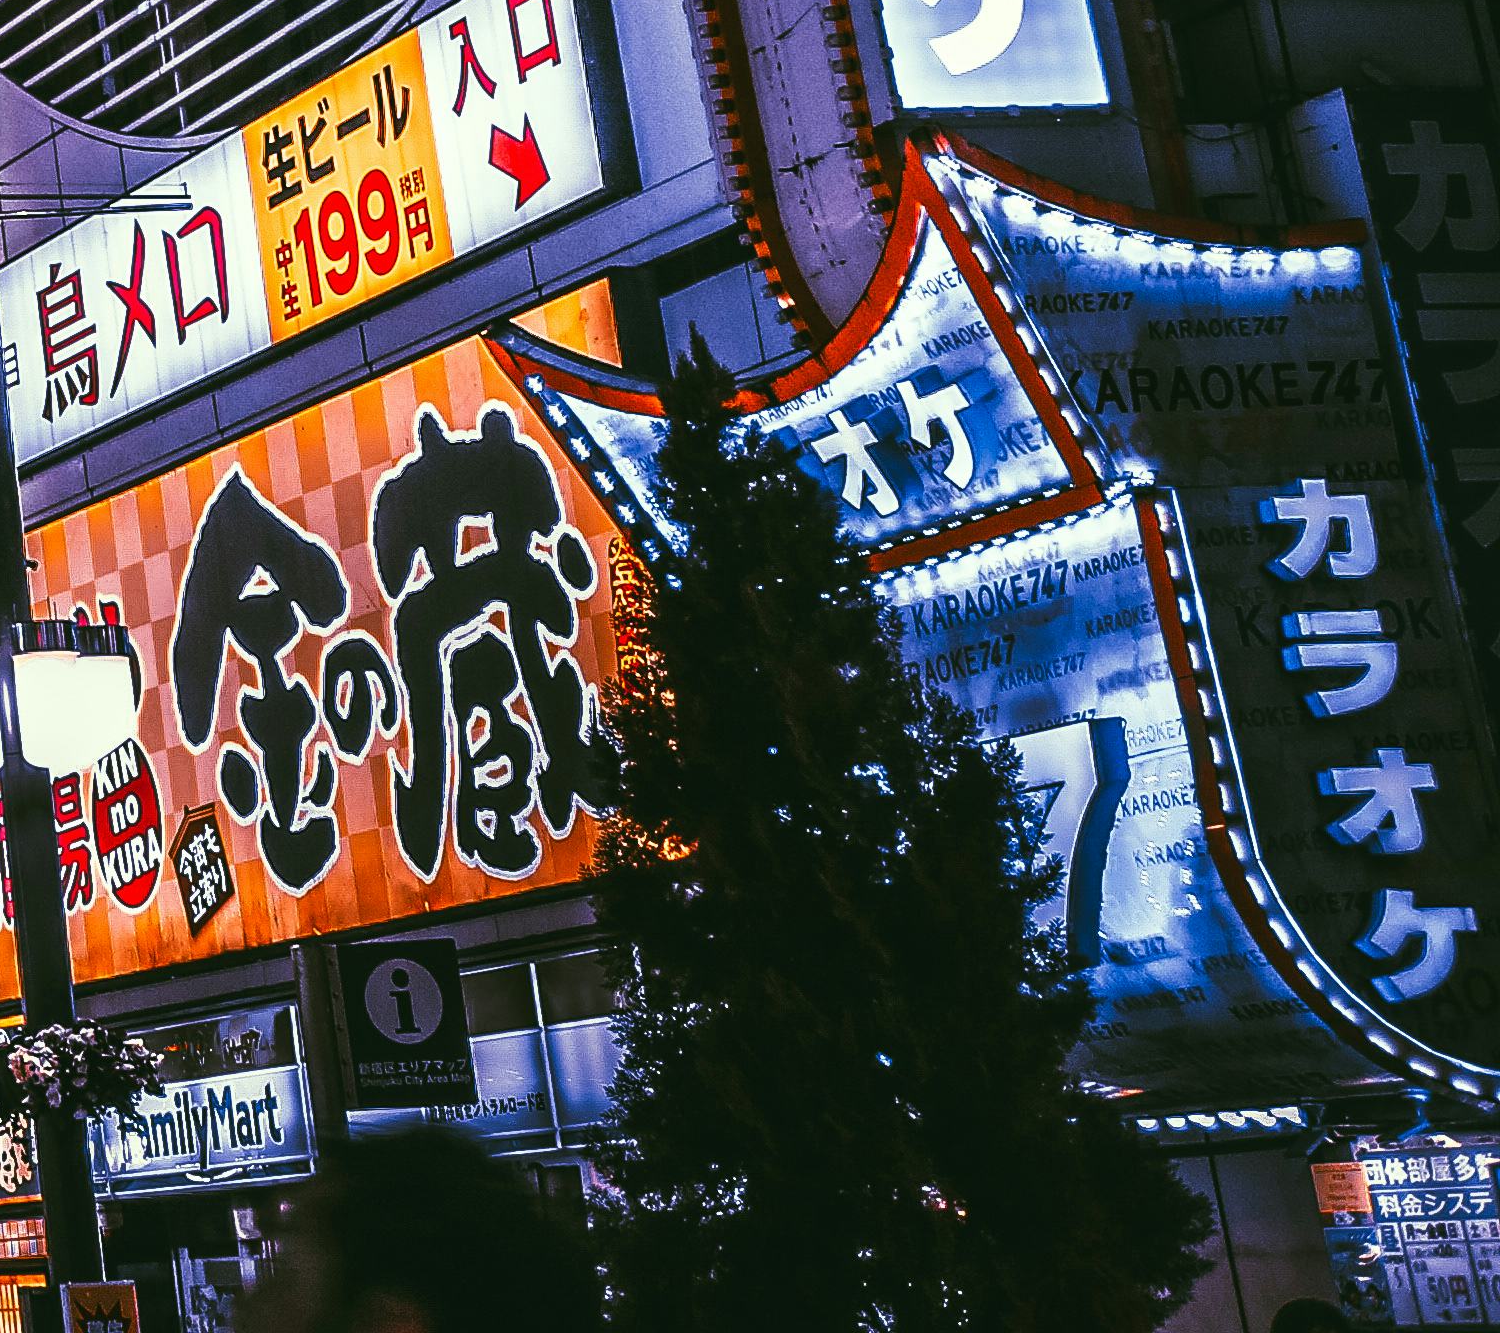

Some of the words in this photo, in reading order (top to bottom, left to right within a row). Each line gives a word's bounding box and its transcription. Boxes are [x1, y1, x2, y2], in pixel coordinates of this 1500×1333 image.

[262, 65, 412, 210] 生ビール
[275, 237, 300, 322] 中生
[294, 169, 402, 309] 199
[407, 203, 436, 259] 円
[36, 206, 231, 422] 鳥メロ
[1074, 356, 1389, 418] KARAOKE747
[172, 401, 598, 895] 金の蔵
[909, 559, 1070, 635] KARAOKE747
[96, 743, 139, 798] KIN
[1257, 477, 1480, 1002] カラオケ
[102, 837, 162, 889] KURA
[111, 796, 140, 834] no
